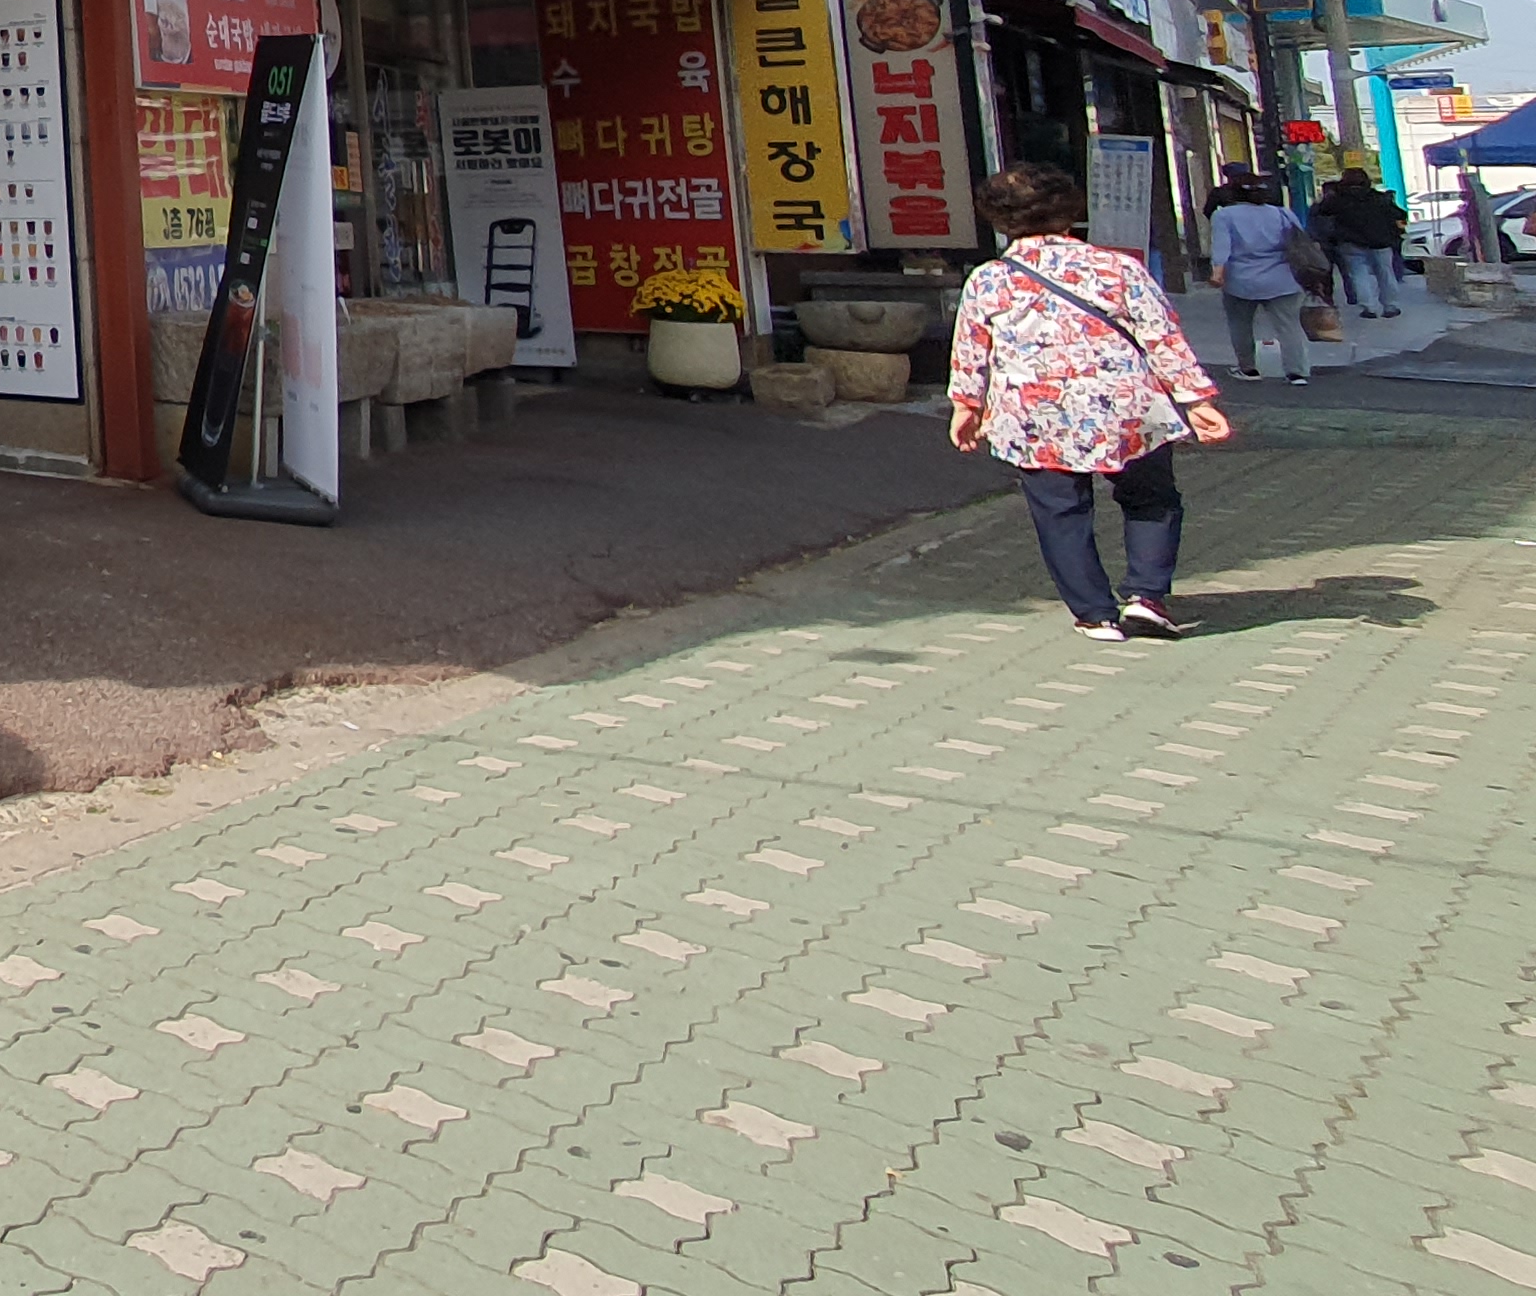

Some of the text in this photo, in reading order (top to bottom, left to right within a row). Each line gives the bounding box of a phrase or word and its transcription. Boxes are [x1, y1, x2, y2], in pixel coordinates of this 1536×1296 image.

[267, 65, 295, 95] 051
[451, 126, 543, 157] 로봇이
[871, 57, 951, 237] 낙지볶음
[561, 176, 725, 222] 뼈다귀전골
